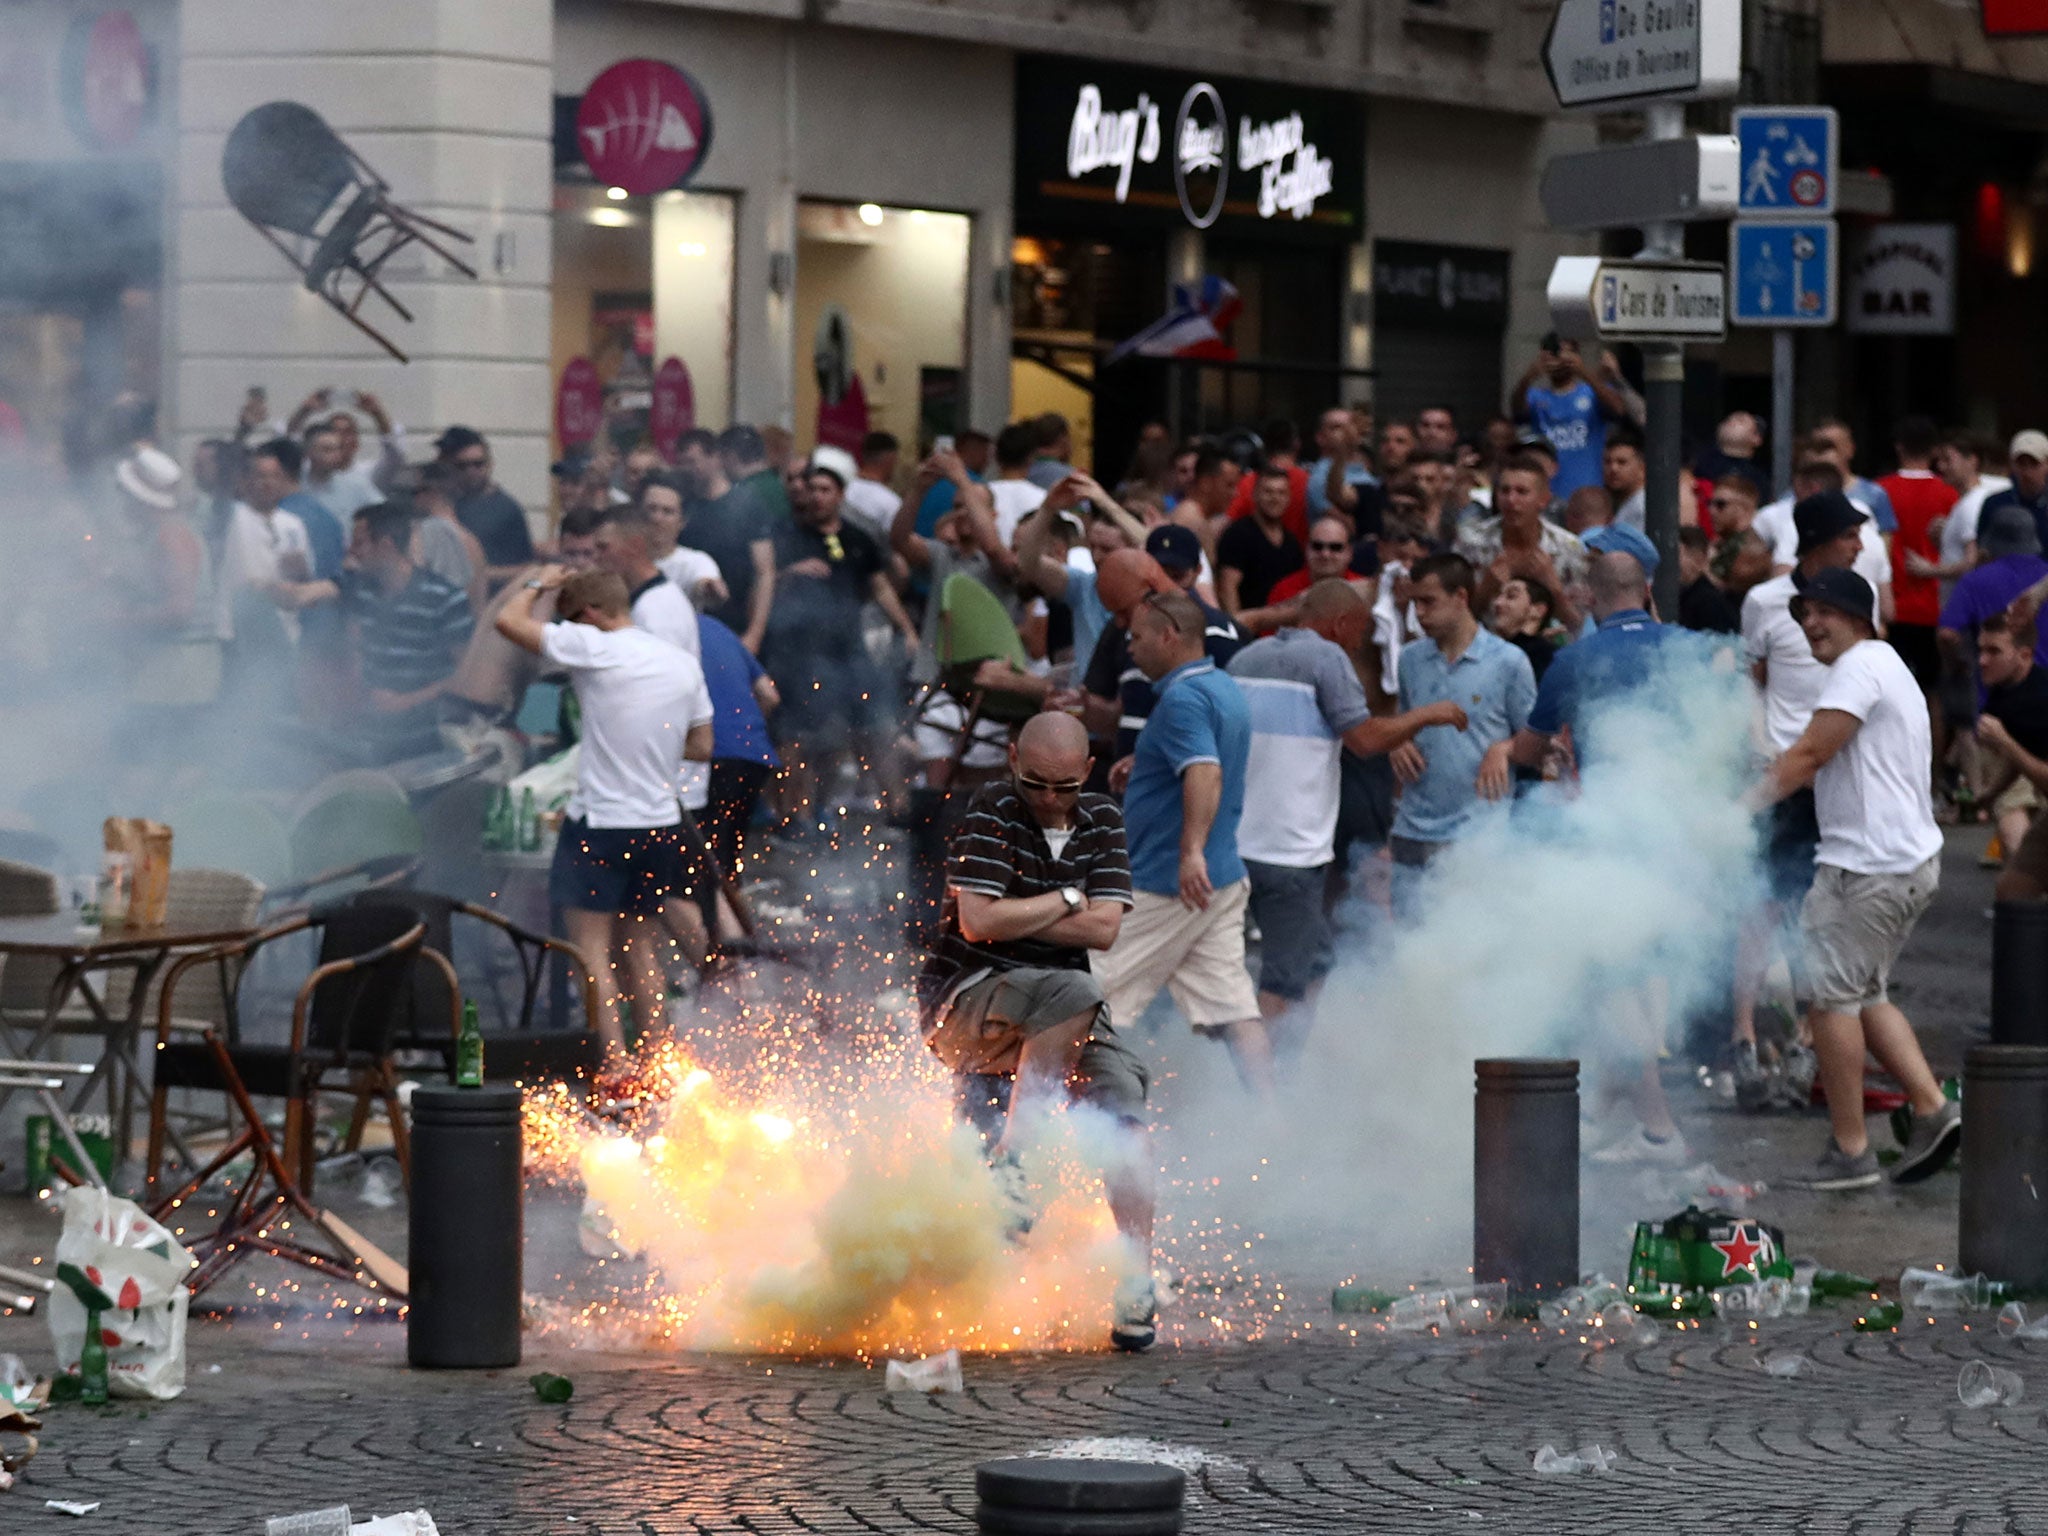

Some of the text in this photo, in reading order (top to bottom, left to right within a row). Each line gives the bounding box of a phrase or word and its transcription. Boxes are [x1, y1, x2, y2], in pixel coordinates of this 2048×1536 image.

[1617, 5, 1637, 38] De
[1571, 49, 1689, 84] Office de Tourisme
[1620, 282, 1646, 317] Cars
[1652, 285, 1666, 317] de
[1673, 283, 1720, 318] Tourisme
[1861, 290, 1931, 316] BAR
